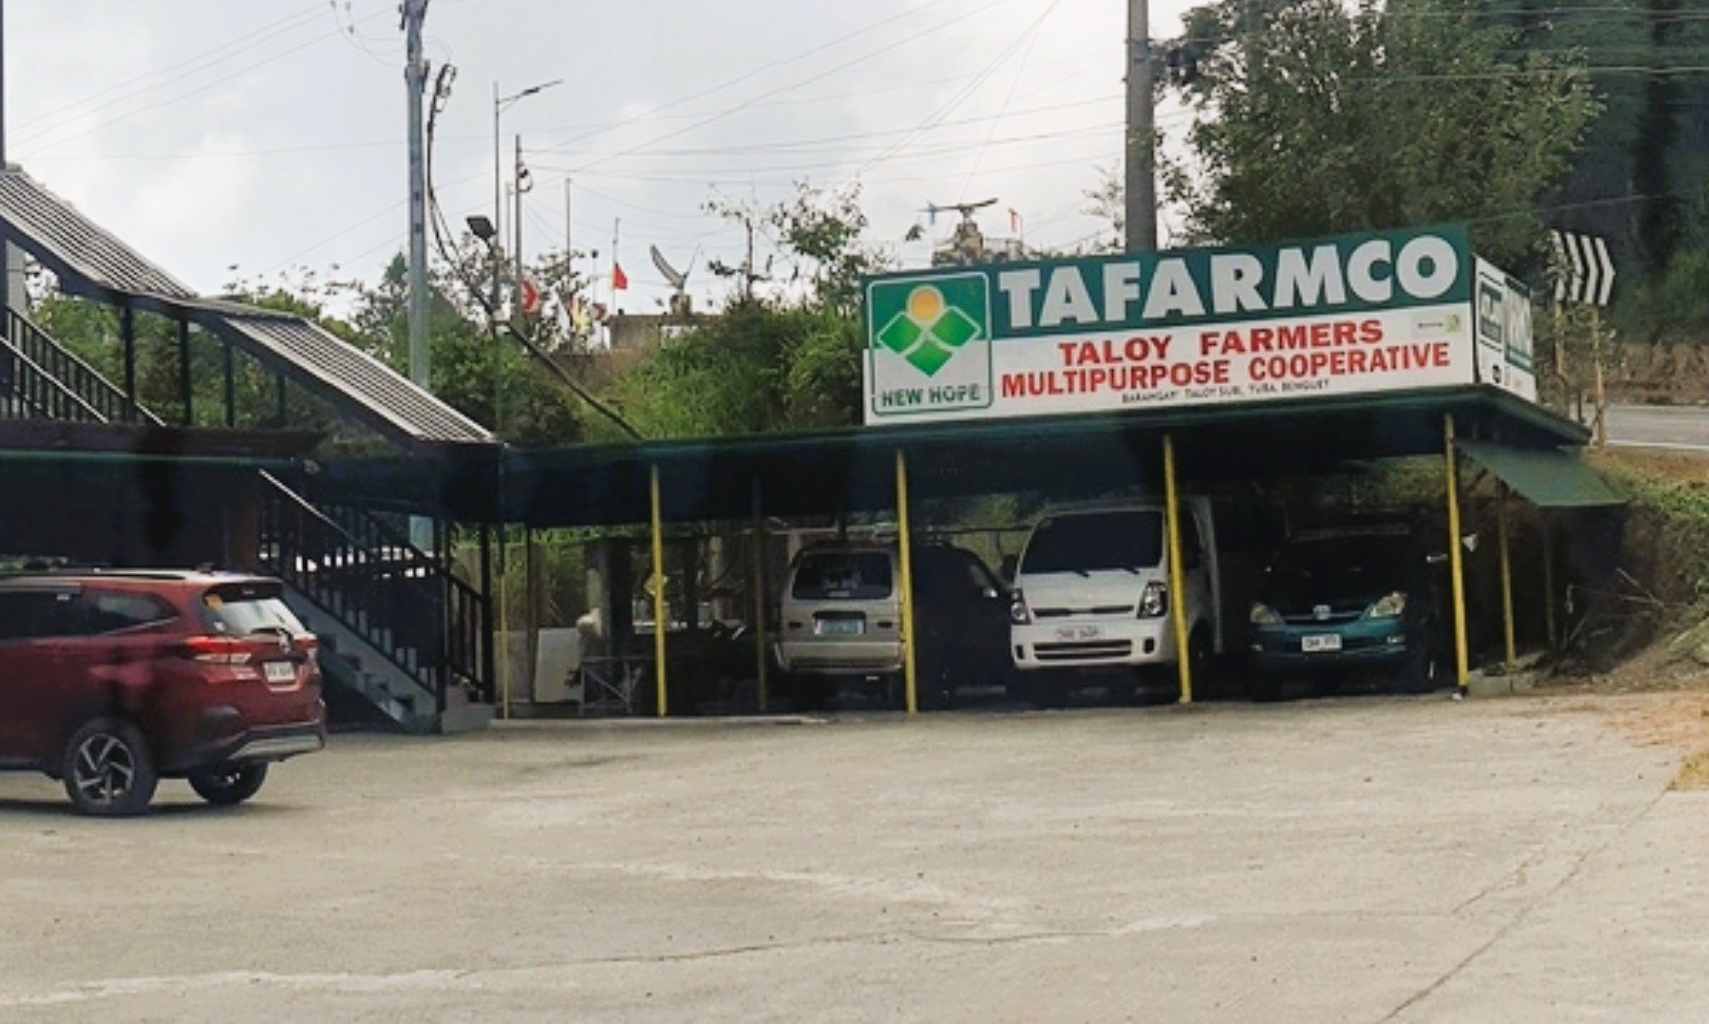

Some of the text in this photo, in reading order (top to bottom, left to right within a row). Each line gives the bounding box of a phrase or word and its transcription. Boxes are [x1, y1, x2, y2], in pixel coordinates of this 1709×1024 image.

[998, 235, 1458, 328] TAFARMCO
[1058, 319, 1384, 366] TALOY FARMERS
[1001, 361, 1230, 398] MULTIPURPOSE
[1248, 343, 1452, 382] COOPERATIVE
[1282, 378, 1330, 392] BENGUET
[881, 383, 981, 407] NEW HOPE
